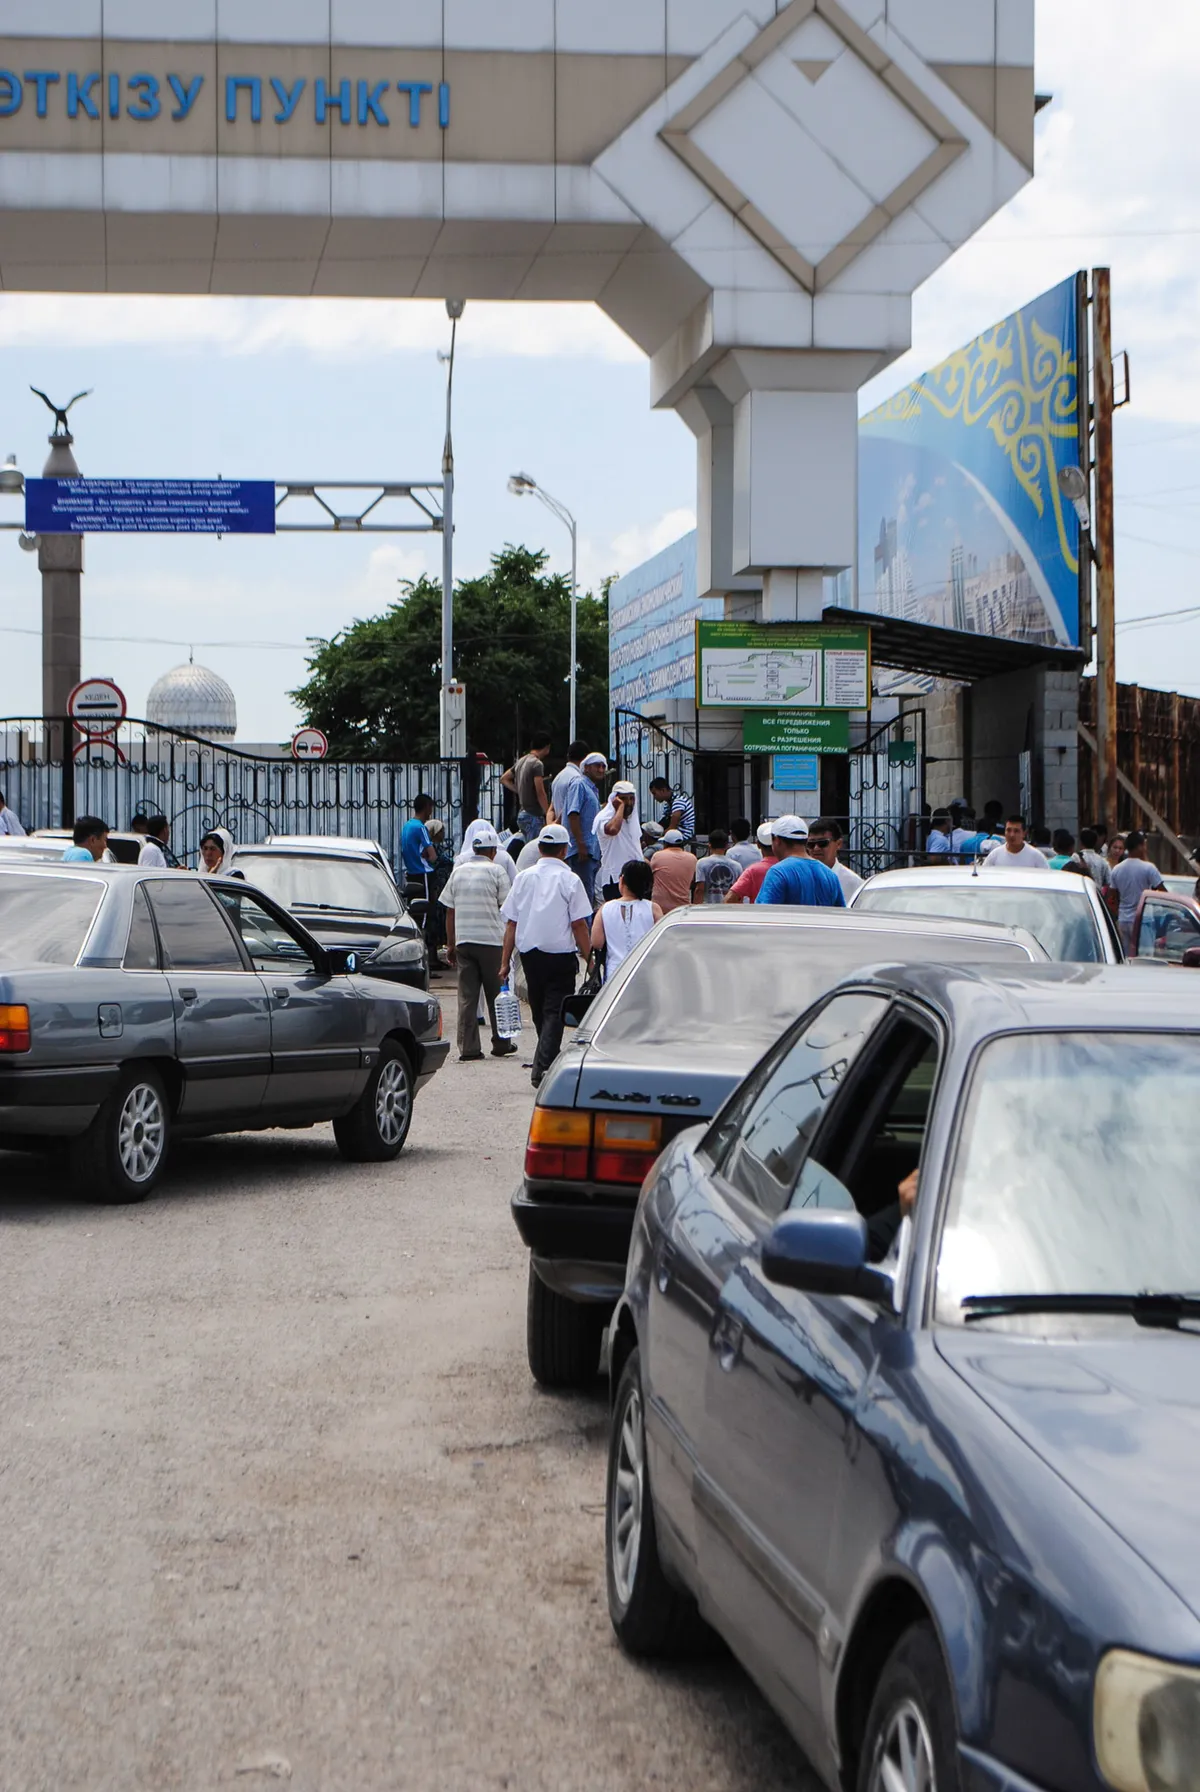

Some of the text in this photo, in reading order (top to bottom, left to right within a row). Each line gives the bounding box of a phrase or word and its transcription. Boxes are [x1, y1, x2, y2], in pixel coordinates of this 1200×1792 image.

[225, 75, 451, 128] ПУНКТІ
[783, 727, 809, 735] ТОЛЬКО
[781, 745, 822, 753] ПОГРАНИЧНОЙ
[590, 1088, 701, 1107] Audi 100
